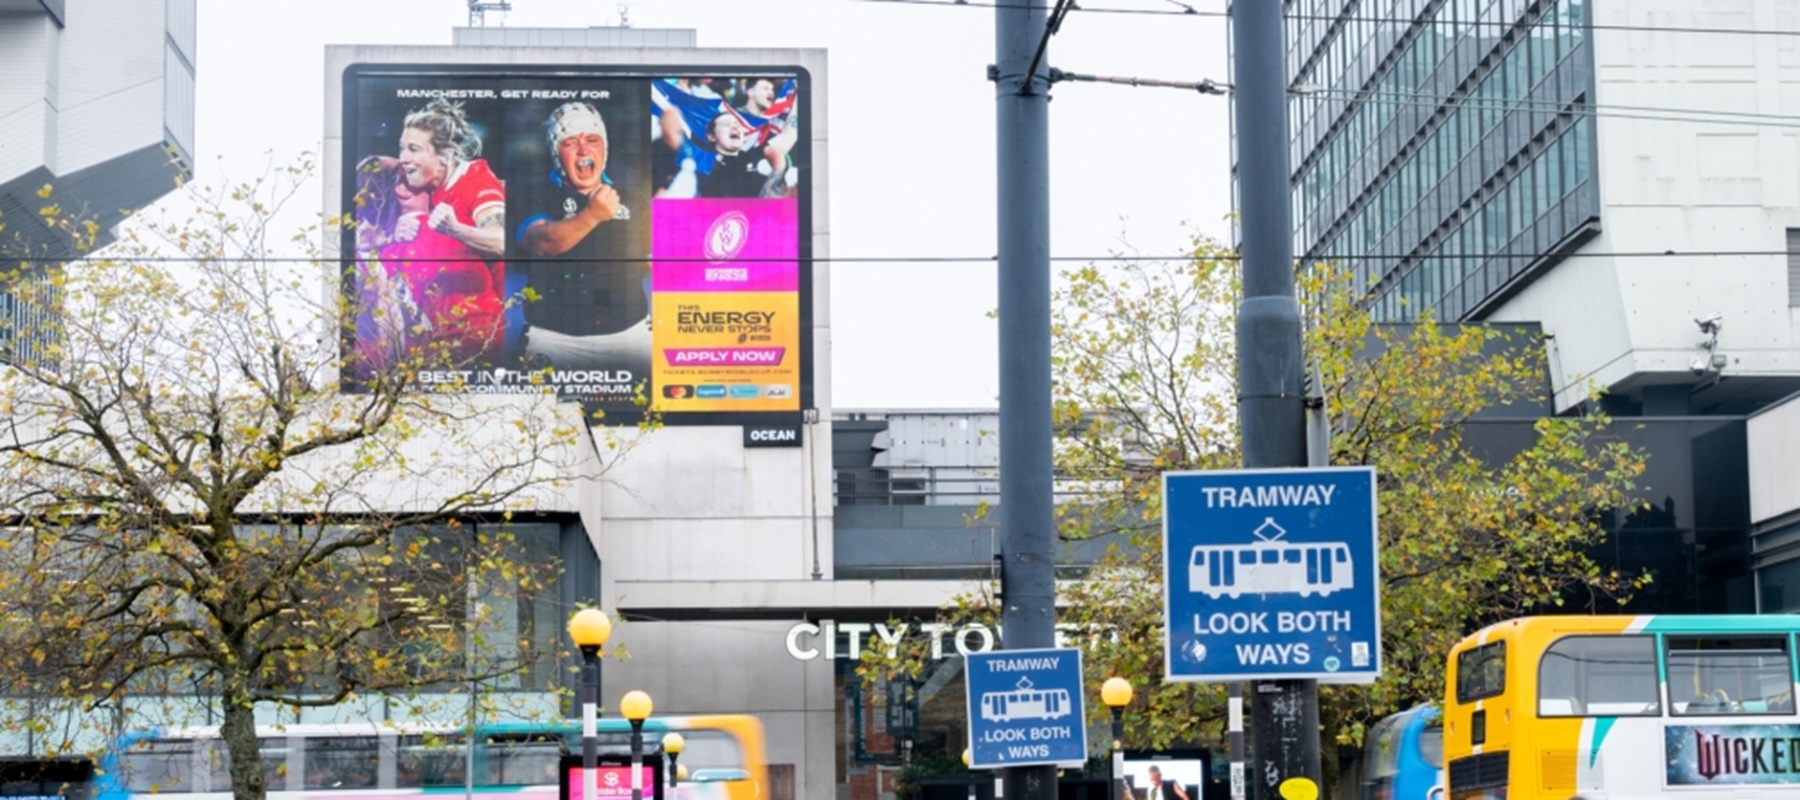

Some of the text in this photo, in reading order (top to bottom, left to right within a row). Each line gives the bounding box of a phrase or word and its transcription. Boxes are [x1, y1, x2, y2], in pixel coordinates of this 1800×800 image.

[396, 89, 610, 99] MANCHESTER, GET READY FOR
[677, 311, 776, 324] ENERGY
[677, 324, 772, 333] NEVER STOPS
[675, 350, 776, 361] APPLY NOW
[417, 370, 633, 383] BEST IN THE WORLD
[564, 384, 632, 394] STADIUM
[750, 430, 796, 441] OCEAN
[1202, 484, 1336, 508] TRAMWAY
[1194, 610, 1351, 634] LOOK BOTH
[786, 622, 908, 660] CITY
[1235, 643, 1311, 666] WAYS
[986, 657, 1059, 672] TRAMWAY
[985, 726, 1071, 743] LOOK BOTH
[1008, 744, 1050, 758] WAYS
